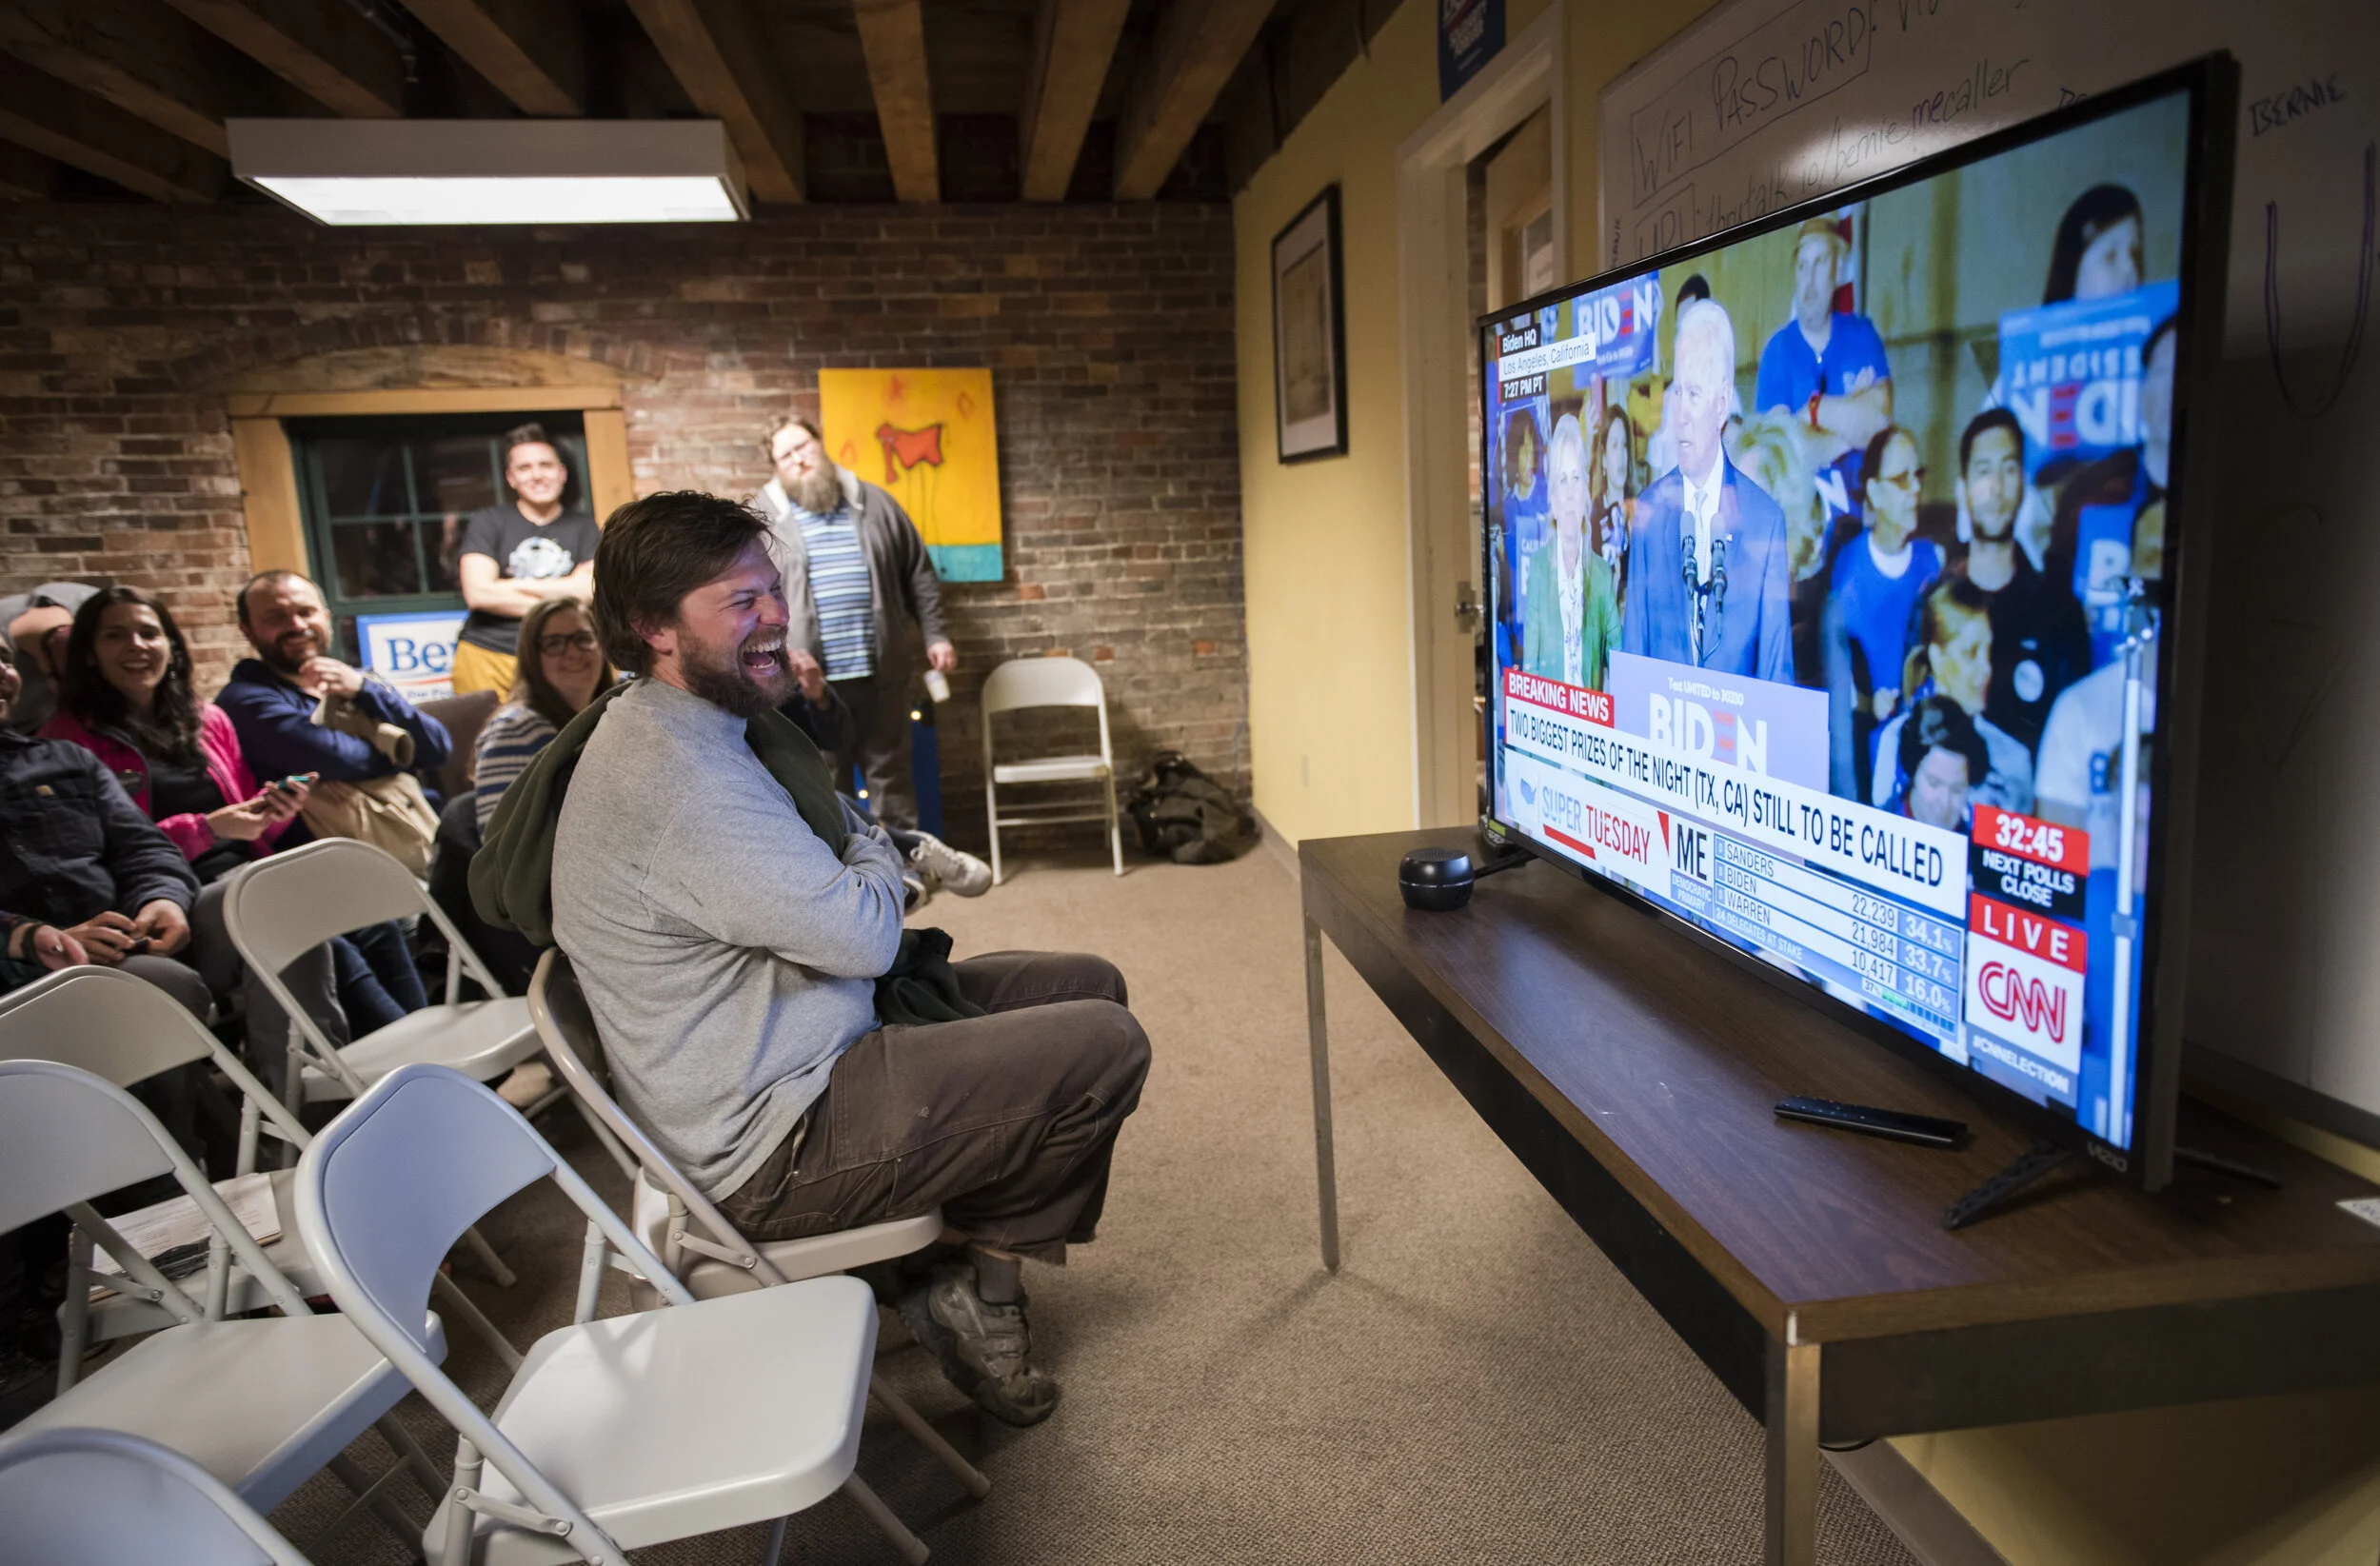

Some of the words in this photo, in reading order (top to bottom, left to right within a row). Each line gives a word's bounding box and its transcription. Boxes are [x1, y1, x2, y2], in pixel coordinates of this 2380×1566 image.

[2248, 69, 2349, 137] BERNIE
[1635, 109, 1693, 191] WIFI
[1502, 333, 1523, 354] Biden
[1524, 328, 1537, 347] HQ
[1577, 283, 1653, 347] BIDEN
[1503, 360, 1517, 376] Los
[1517, 351, 1549, 374] Angeles,
[1551, 342, 1590, 364] California
[1503, 380, 1520, 399] 7:27
[1521, 378, 1533, 396] PM
[1534, 375, 1544, 393] PT
[1508, 672, 1567, 710] BREAKING
[1570, 688, 1610, 723] NEWS
[1650, 692, 1768, 777] BIDEN
[1511, 709, 1528, 739] TWO
[1532, 716, 1569, 753] BIGGEST
[1572, 729, 1606, 767] PRIZES
[1610, 742, 1623, 772] OF
[1627, 747, 1649, 783] THE
[1653, 756, 1691, 798] NIGHT
[1695, 766, 1719, 816] (TX,
[1723, 779, 1749, 827] CA)
[1753, 788, 1795, 837] STILL
[1800, 804, 1824, 846] TO
[1831, 813, 1854, 858] BE
[1861, 824, 1943, 887] CALLED
[1542, 785, 1582, 834] SUPER
[1586, 803, 1652, 865] TUESDAY
[1677, 823, 1708, 882] ME
[1995, 812, 2065, 863] 32:45
[1672, 872, 1713, 902] DEMOCRATIC
[1677, 888, 1706, 913] PRIMARY
[1727, 842, 1775, 878] SANDERS
[1852, 893, 1895, 928] 22,239
[1982, 848, 2023, 877] NEXT
[2023, 862, 2075, 895] POLLS
[2000, 875, 2053, 908] CLOSE
[1716, 906, 1726, 921] 24
[1727, 916, 1766, 942] DELEGATES
[1767, 931, 1776, 946] AT
[1777, 938, 1803, 961] STAKE
[1727, 866, 1757, 895] BIDEN
[1852, 921, 1894, 958] 21,984
[1727, 889, 1771, 926] WARREN
[1852, 949, 1894, 984] 10,417
[1983, 904, 2070, 962] LIVE
[1979, 961, 2067, 1044] CNN
